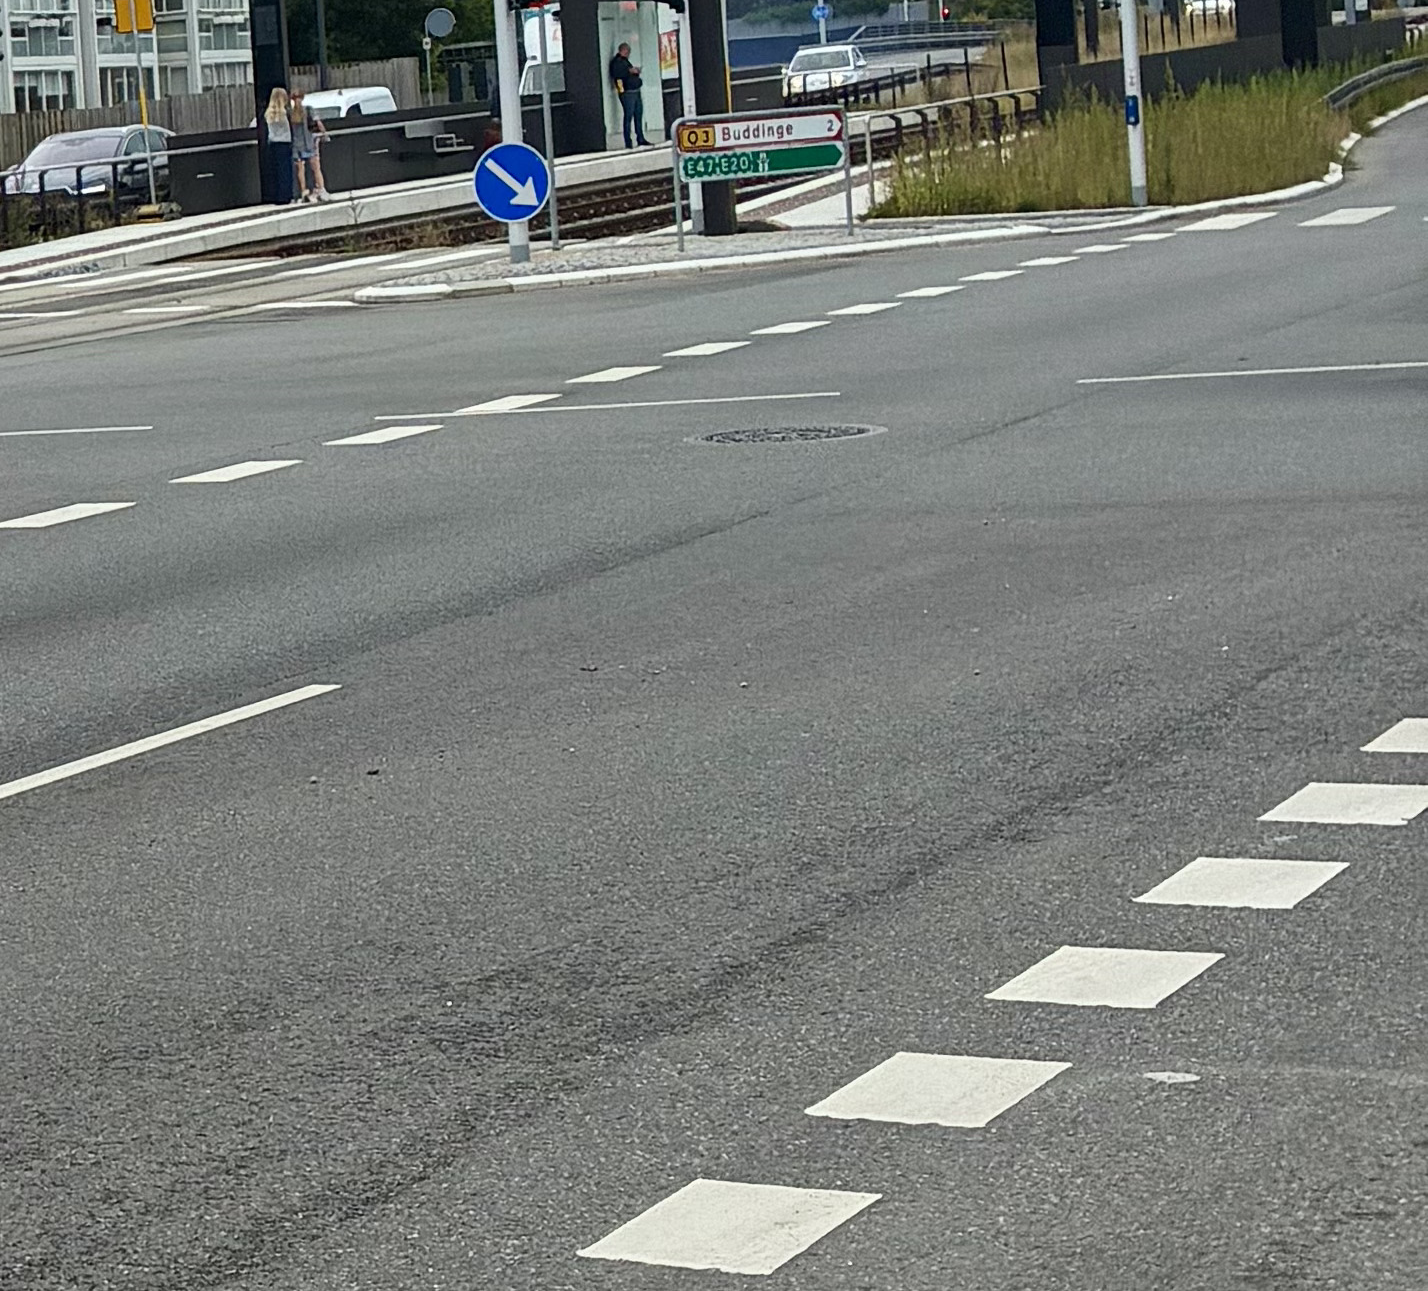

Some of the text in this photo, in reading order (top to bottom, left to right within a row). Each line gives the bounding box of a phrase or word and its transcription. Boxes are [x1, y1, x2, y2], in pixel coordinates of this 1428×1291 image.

[721, 123, 794, 142] Buddinge
[826, 119, 835, 132] 2
[687, 157, 749, 175] E47 E20
